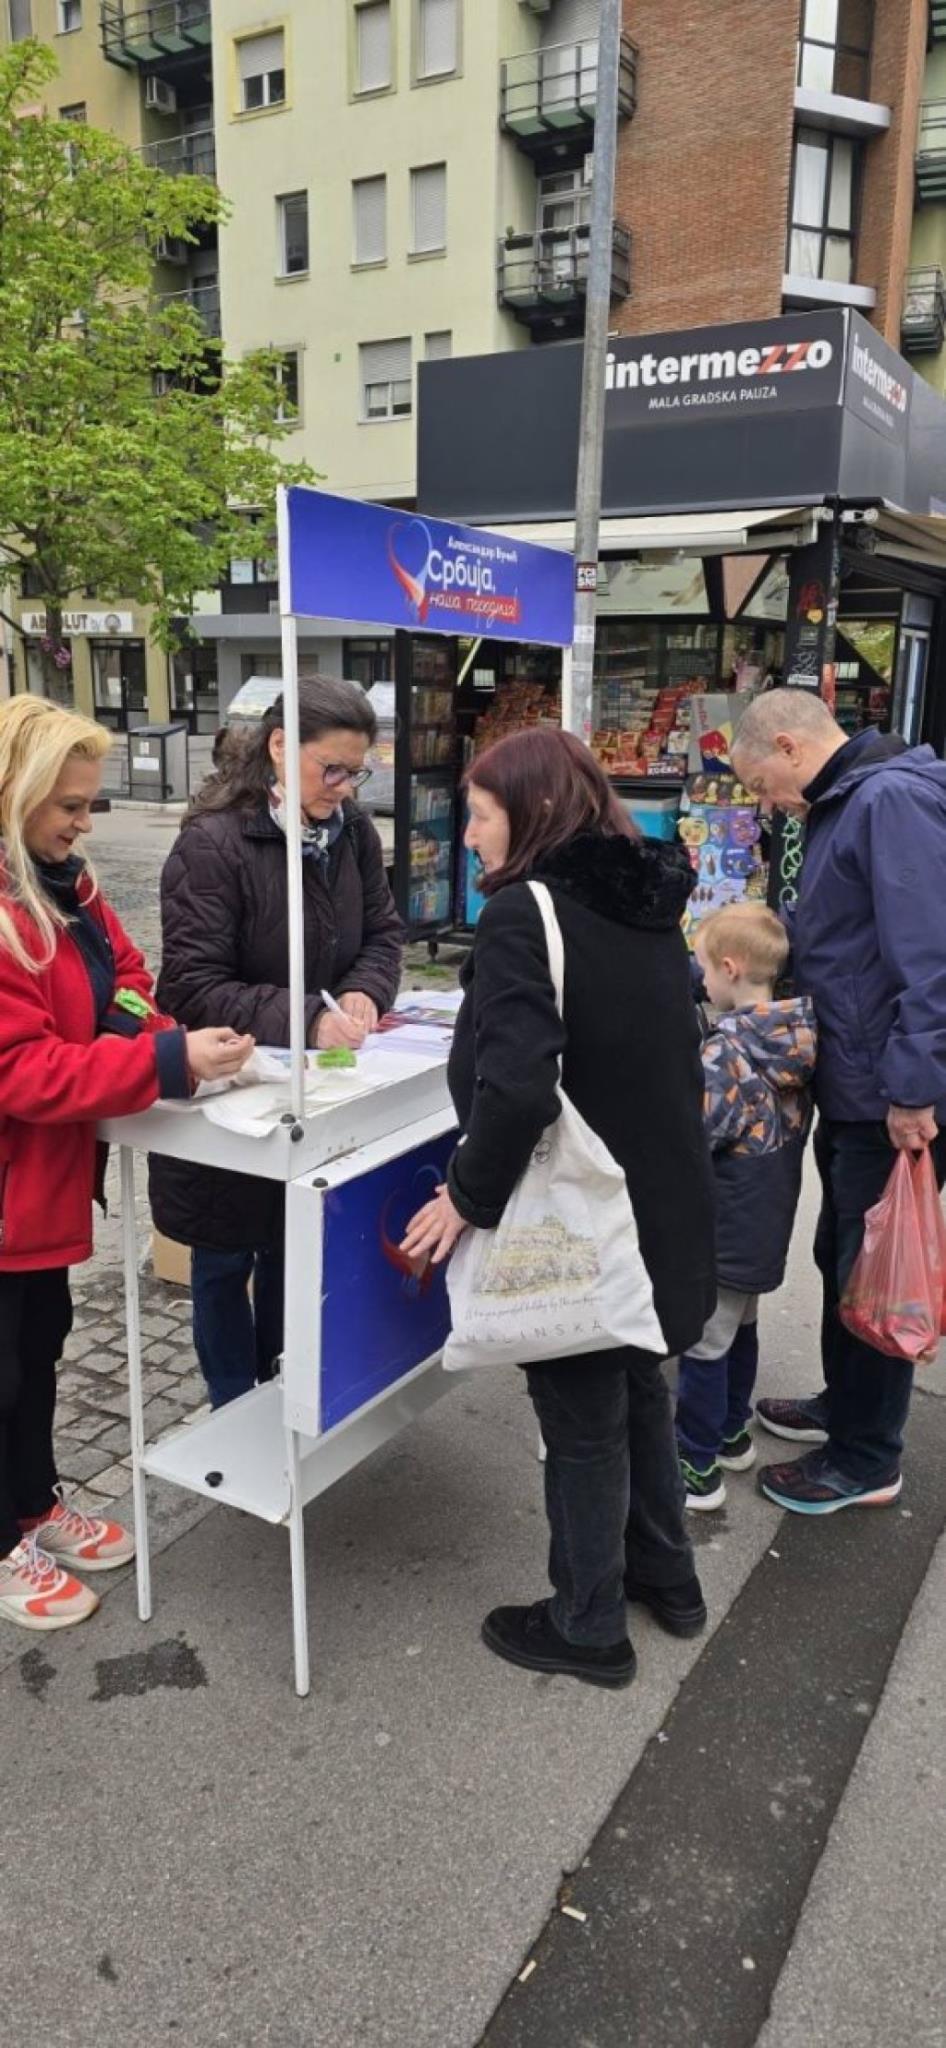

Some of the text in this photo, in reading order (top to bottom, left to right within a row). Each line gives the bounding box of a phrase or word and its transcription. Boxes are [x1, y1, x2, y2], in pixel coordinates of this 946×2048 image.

[605, 339, 833, 390] intermezzo
[648, 386, 778, 409] MALA GRADSKA PAUZA
[428, 549, 496, 596] Србија,
[430, 592, 462, 610] наша
[31, 614, 88, 629] ABLUT
